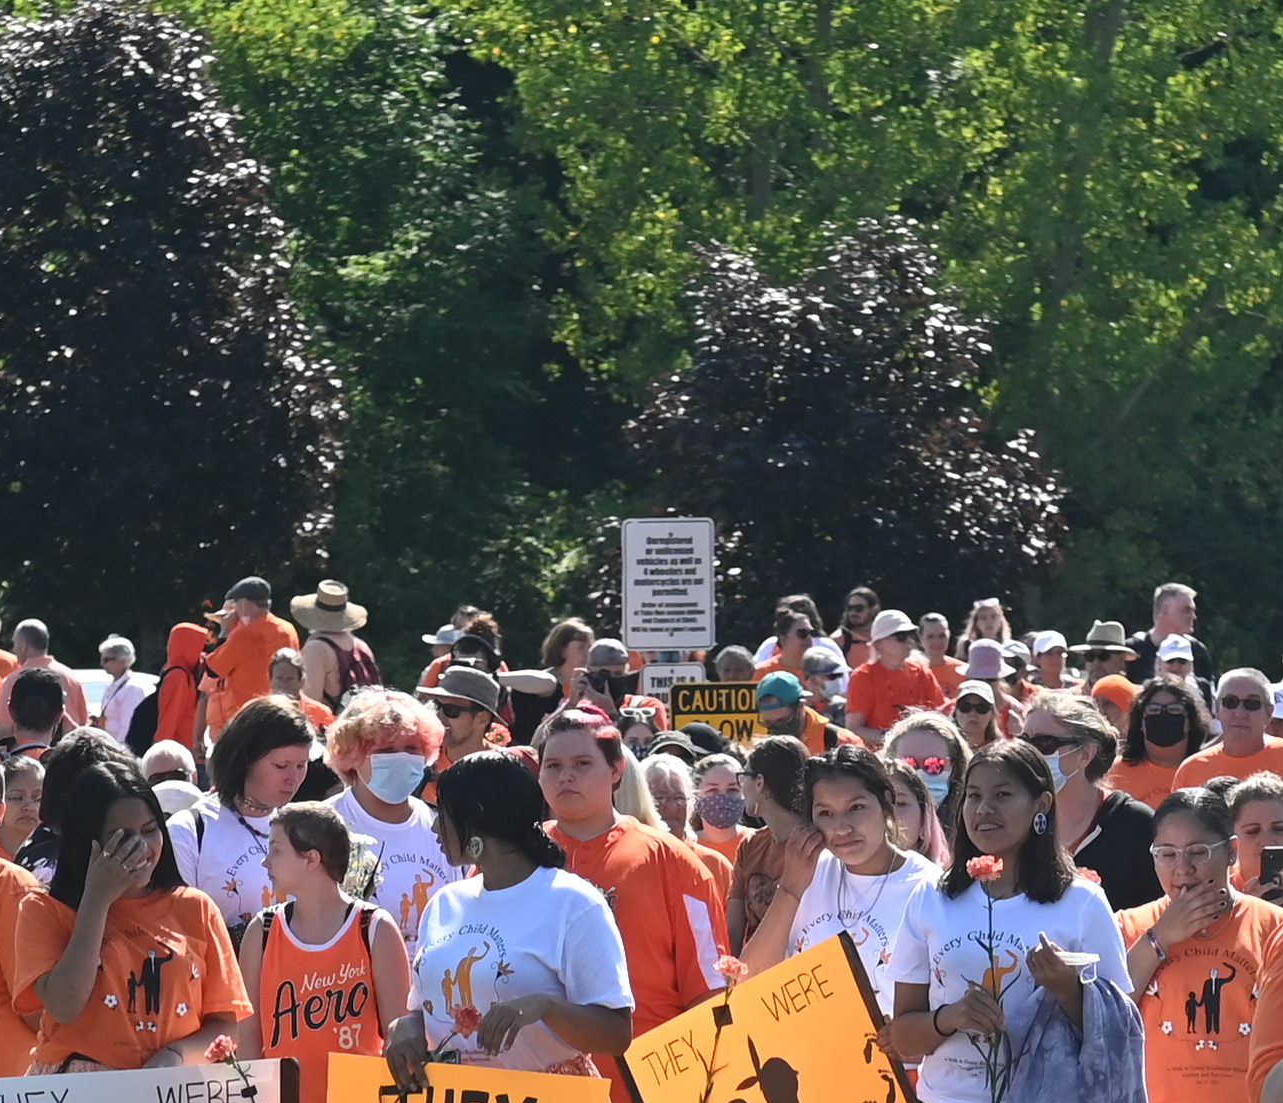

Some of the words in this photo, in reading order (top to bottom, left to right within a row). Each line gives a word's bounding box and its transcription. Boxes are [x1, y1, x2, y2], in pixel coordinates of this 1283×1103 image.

[389, 852, 417, 865] Child
[418, 855, 450, 887] Matters
[458, 923, 488, 936] Child
[486, 926, 508, 960] Matters
[801, 911, 833, 936] Every
[862, 913, 890, 949] Matters
[932, 935, 962, 966] Every
[1184, 947, 1219, 957] Child
[1221, 949, 1257, 981] Matters
[300, 972, 336, 994] New
[337, 958, 366, 985] York
[270, 978, 369, 1049] Aero
[641, 1029, 699, 1087] THEY
[760, 963, 834, 1023] WERE
[333, 1023, 362, 1050] '87
